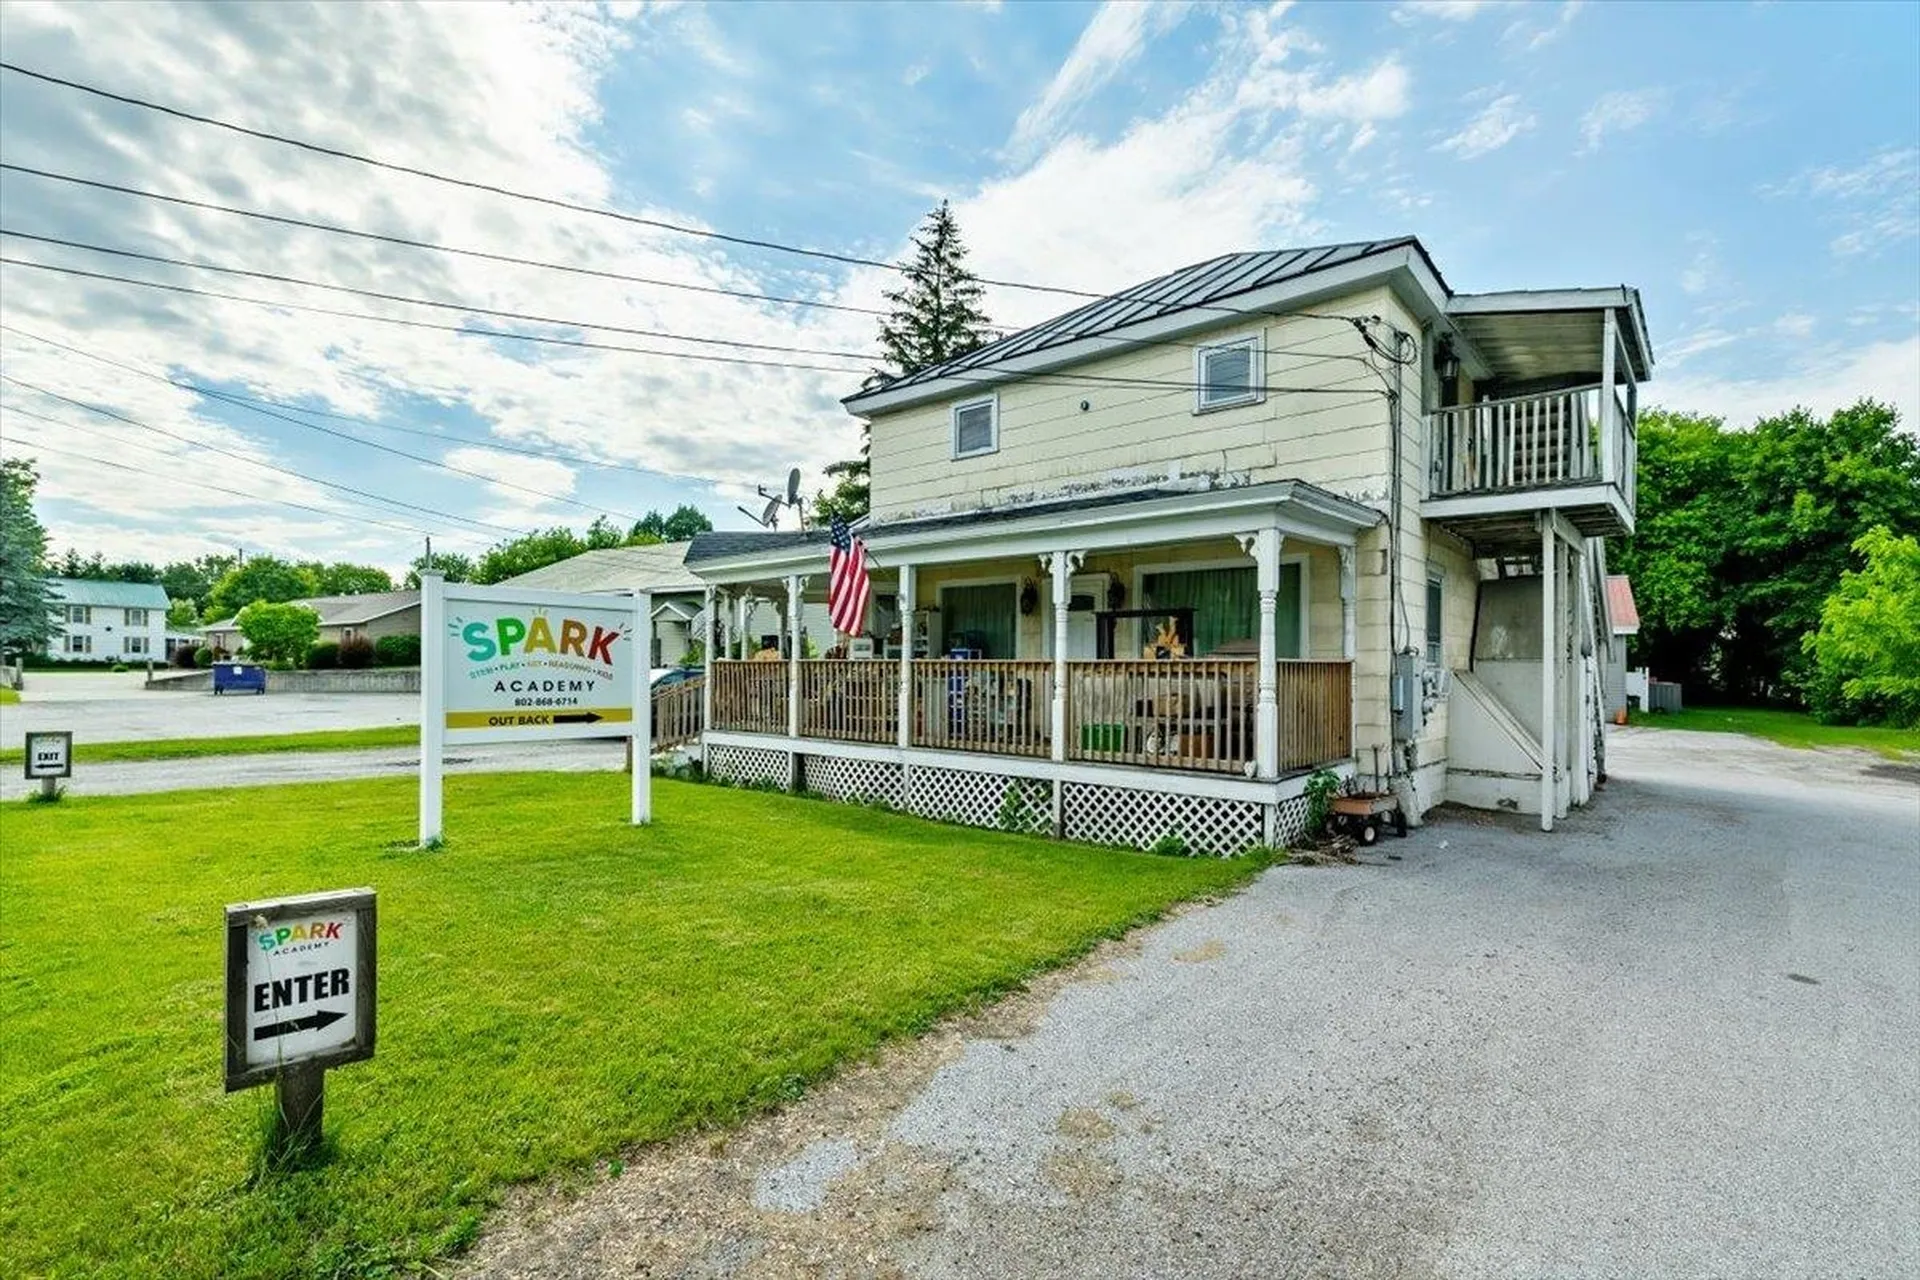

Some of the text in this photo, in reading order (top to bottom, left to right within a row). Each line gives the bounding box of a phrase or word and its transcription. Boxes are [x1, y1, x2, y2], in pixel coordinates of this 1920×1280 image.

[462, 617, 619, 665] SPARK
[493, 680, 595, 692] ACADEMY
[514, 697, 578, 706] 802-868-6714
[488, 715, 549, 727] OUT BACK
[38, 752, 59, 761] EXIT
[259, 922, 343, 950] SPARK
[273, 941, 330, 956] ACADEMY
[254, 968, 350, 1013] ENTER
